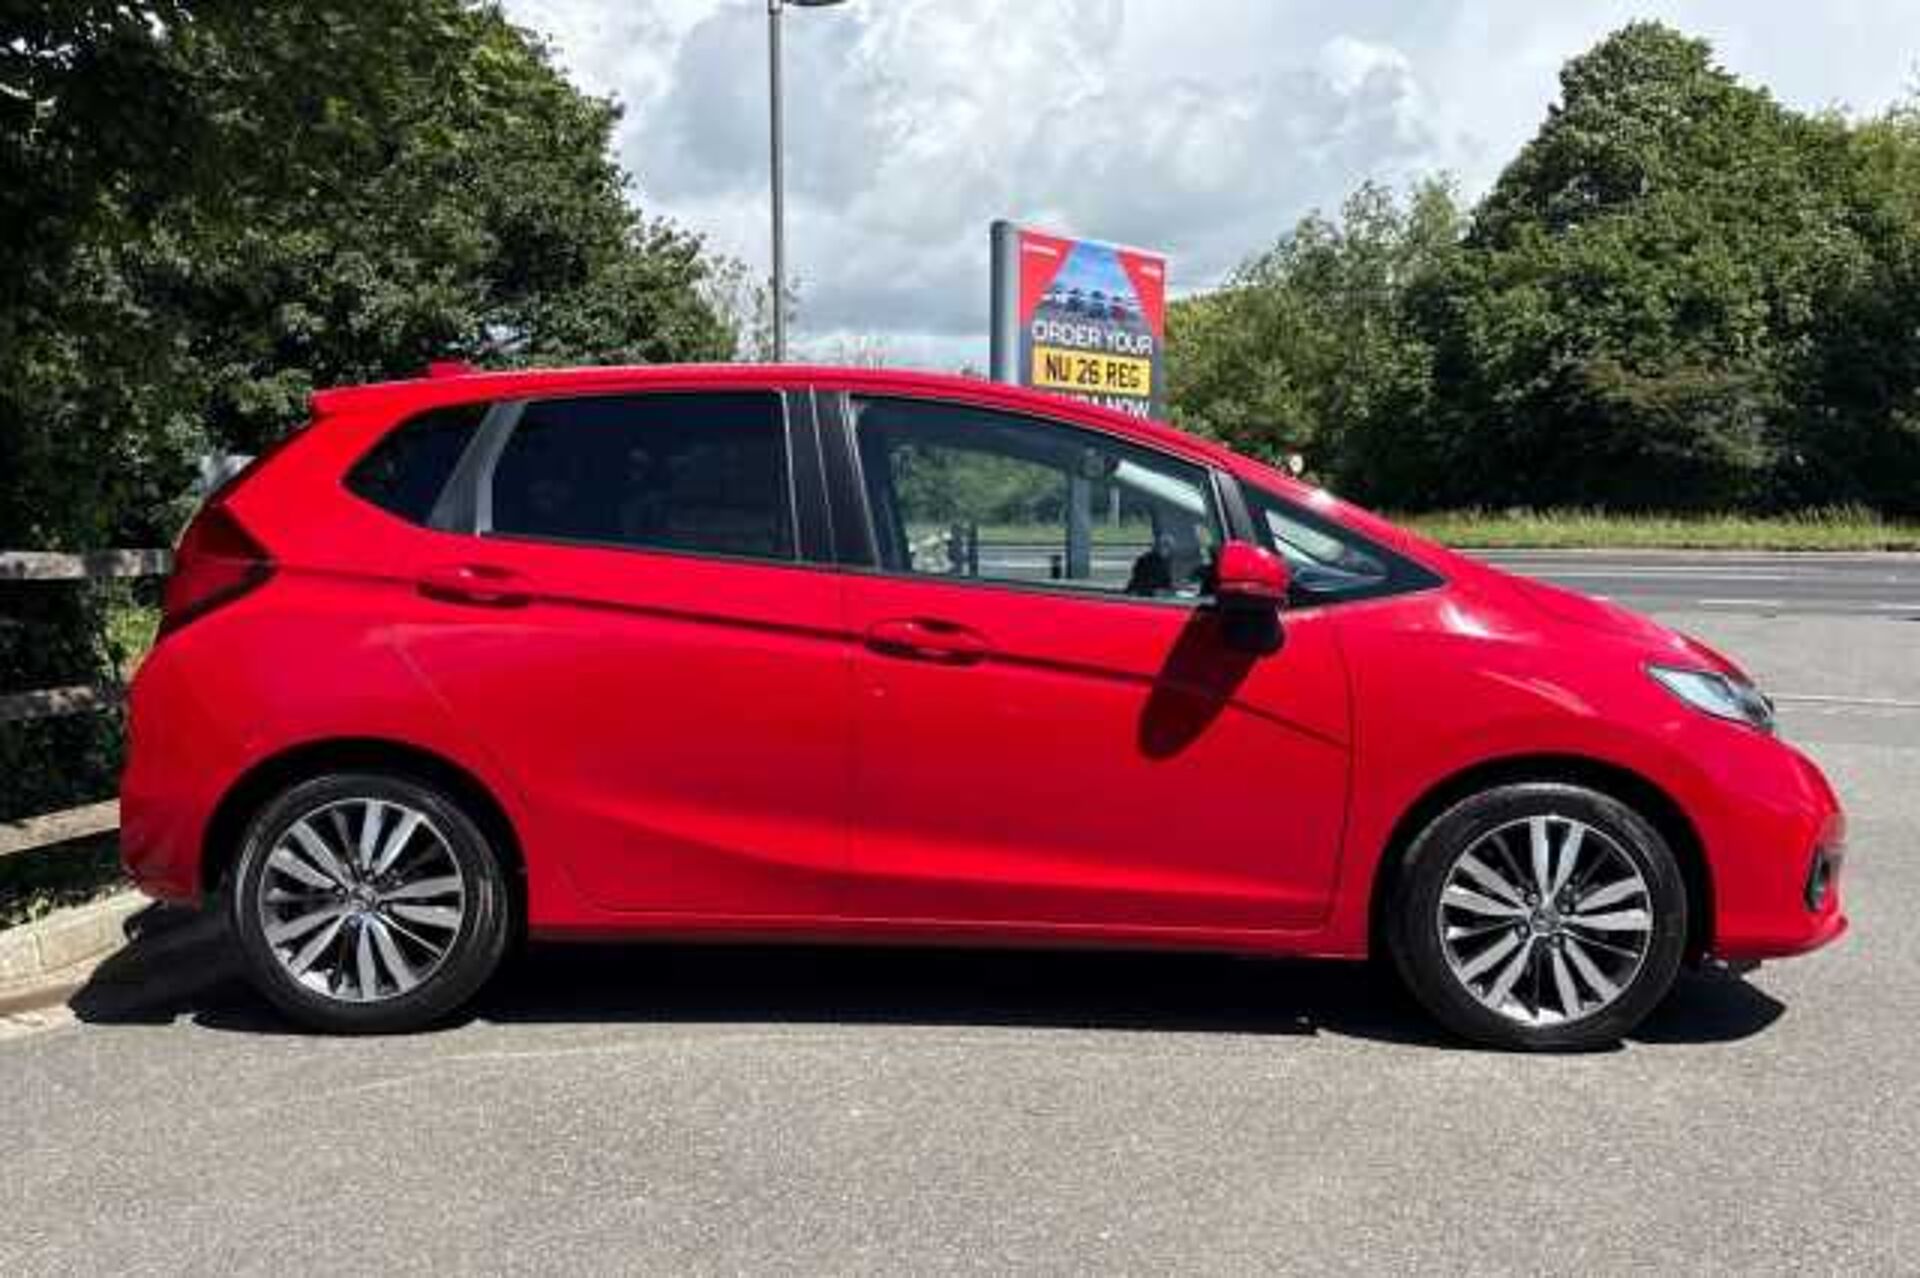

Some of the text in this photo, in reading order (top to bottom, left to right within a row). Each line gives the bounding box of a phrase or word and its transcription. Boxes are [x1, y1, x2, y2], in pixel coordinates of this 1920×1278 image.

[1032, 320, 1152, 355] ORDER YOUR
[1045, 353, 1140, 388] NU 26 REG
